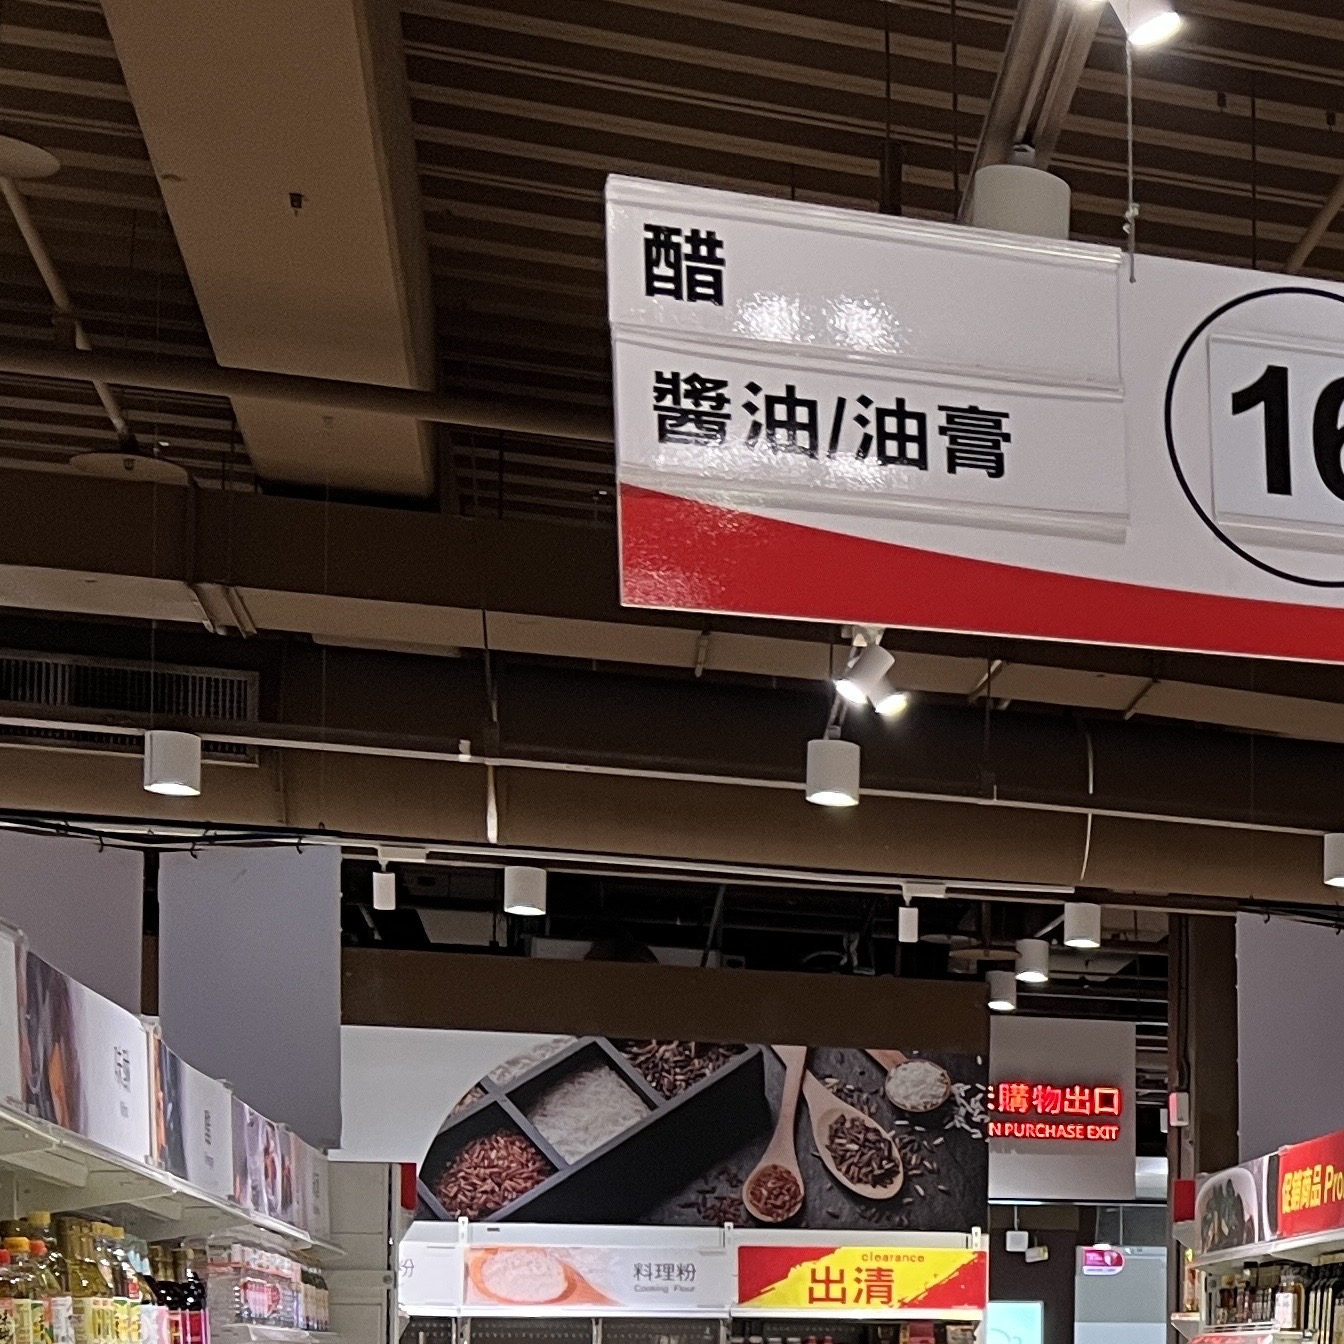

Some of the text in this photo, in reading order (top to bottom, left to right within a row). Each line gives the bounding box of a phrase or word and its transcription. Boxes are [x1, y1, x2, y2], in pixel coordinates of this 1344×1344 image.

[643, 223, 726, 307] 醋
[652, 369, 1012, 480] 醬油/油膏
[1004, 1122, 1085, 1140] PURCHASE
[1086, 1124, 1119, 1141] EXIT
[632, 1262, 697, 1283] 料理粉
[860, 1251, 925, 1264] clearance
[806, 1265, 895, 1306] 出清
